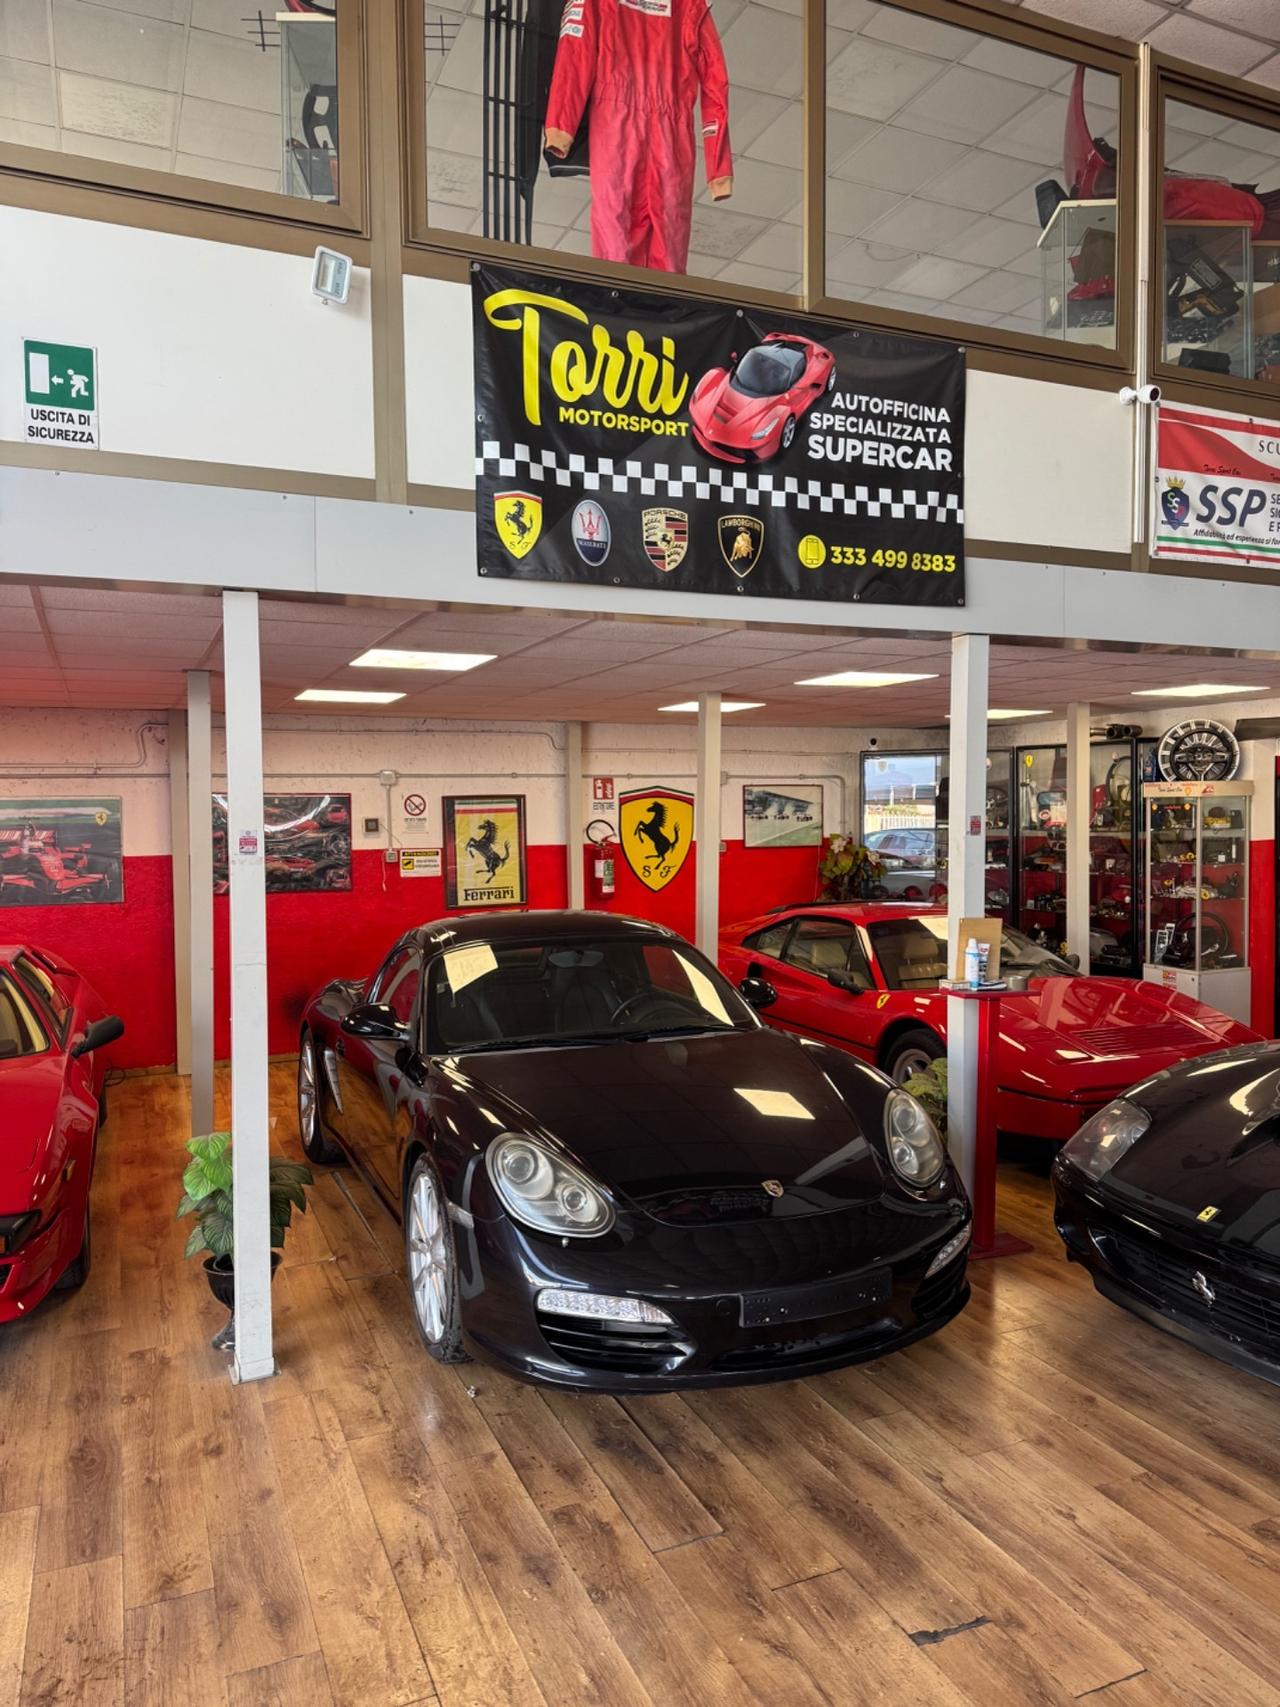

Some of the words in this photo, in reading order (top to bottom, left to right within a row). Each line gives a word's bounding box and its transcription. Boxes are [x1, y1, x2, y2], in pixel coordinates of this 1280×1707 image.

[483, 288, 690, 426] Torri
[30, 408, 75, 424] USCITA
[78, 413, 91, 426] DI
[559, 406, 690, 437] MOTORSPORT
[831, 392, 951, 423] AUTOFFICINA
[27, 425, 95, 444] SICUREZZA
[809, 412, 952, 444] SPECIALIZZATA
[808, 434, 953, 472] SUPERCAR
[643, 508, 686, 520] PORSCHE
[1195, 484, 1267, 528] SSP
[831, 546, 866, 566] 333
[871, 549, 907, 569] 499
[911, 552, 956, 573] 8383
[642, 865, 652, 878] S
[660, 865, 676, 878] F
[463, 886, 515, 902] Ferrari
